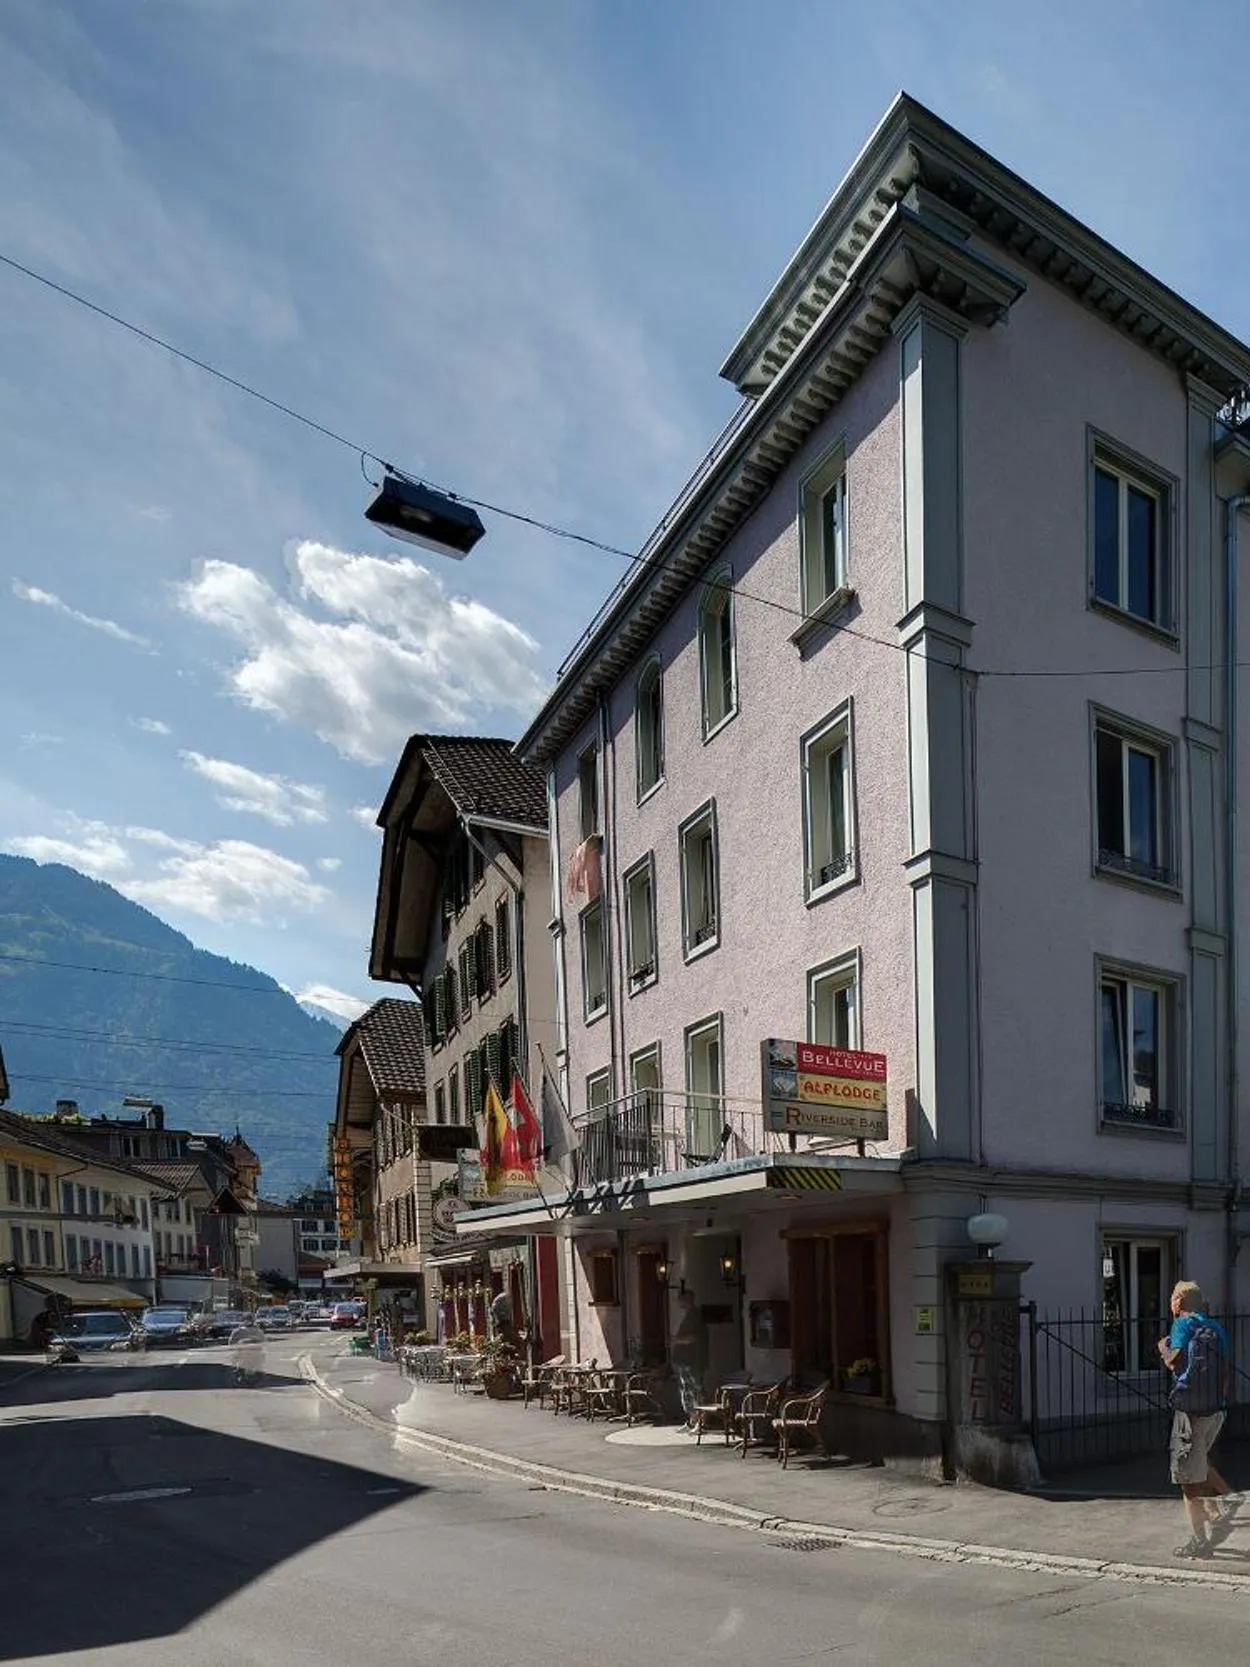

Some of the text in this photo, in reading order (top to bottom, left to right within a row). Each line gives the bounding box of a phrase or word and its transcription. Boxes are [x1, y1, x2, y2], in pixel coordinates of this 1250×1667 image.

[802, 1051, 885, 1073] BELLEVUE
[804, 1081, 881, 1101] ALPLODGE
[967, 1302, 988, 1420] HOTEL
